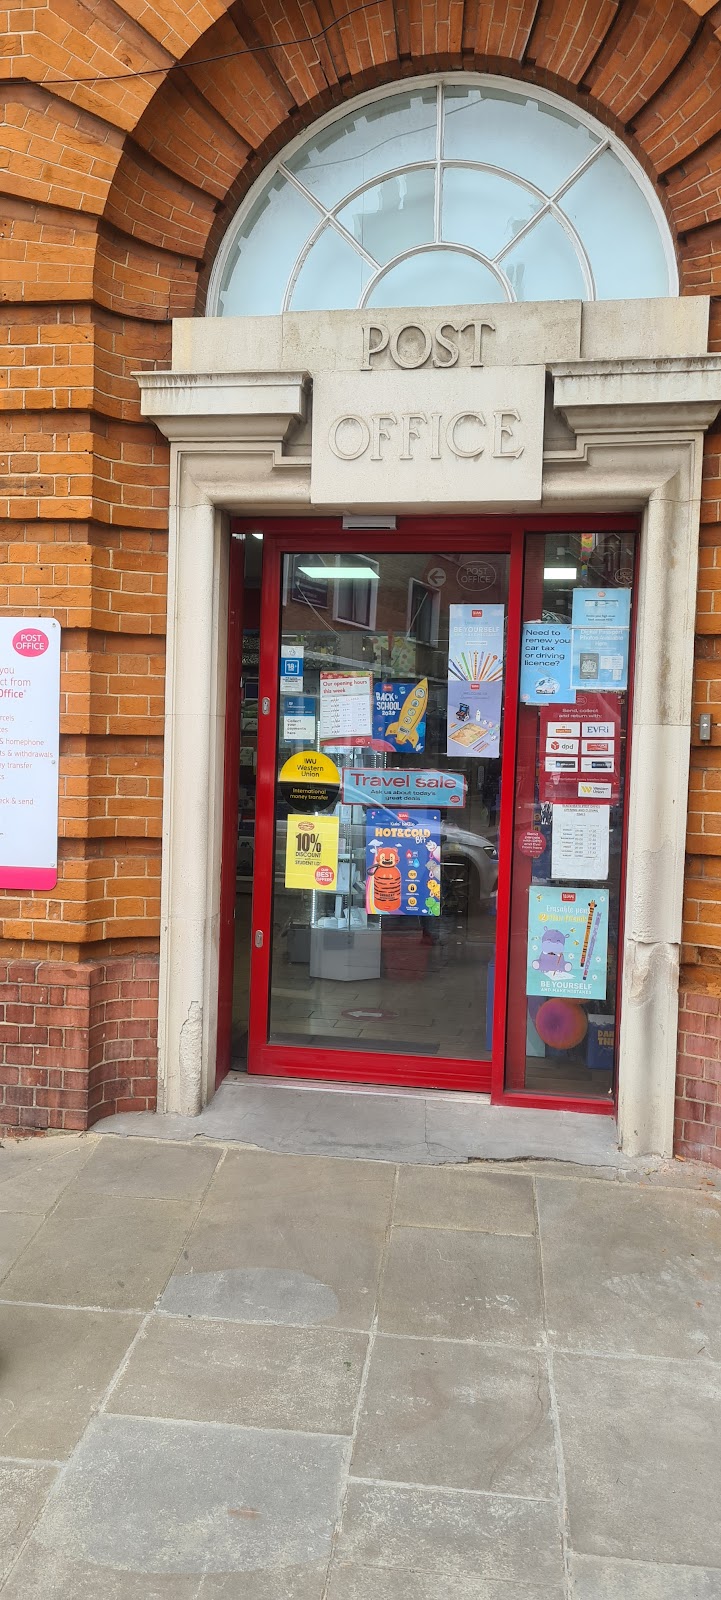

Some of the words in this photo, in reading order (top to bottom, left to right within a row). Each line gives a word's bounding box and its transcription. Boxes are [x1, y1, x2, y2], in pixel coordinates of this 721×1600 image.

[360, 319, 496, 371] POST
[328, 408, 525, 460] OFFICE
[466, 567, 488, 575] POST
[461, 575, 491, 583] OFFICE
[20, 634, 42, 642] POST
[15, 642, 45, 650] OFFICE
[535, 653, 566, 661] driving
[10, 677, 31, 687] from
[375, 692, 395, 702] BACK
[376, 701, 402, 711] SCHOOL
[5, 738, 45, 747] homephone
[14, 750, 54, 758] withdrawals
[351, 773, 409, 787] Travel
[416, 776, 457, 788] sale
[375, 827, 431, 838] HOT&COLD
[295, 833, 322, 853] 10%
[546, 905, 574, 914] Erasable
[552, 981, 592, 990] YOURSELF
